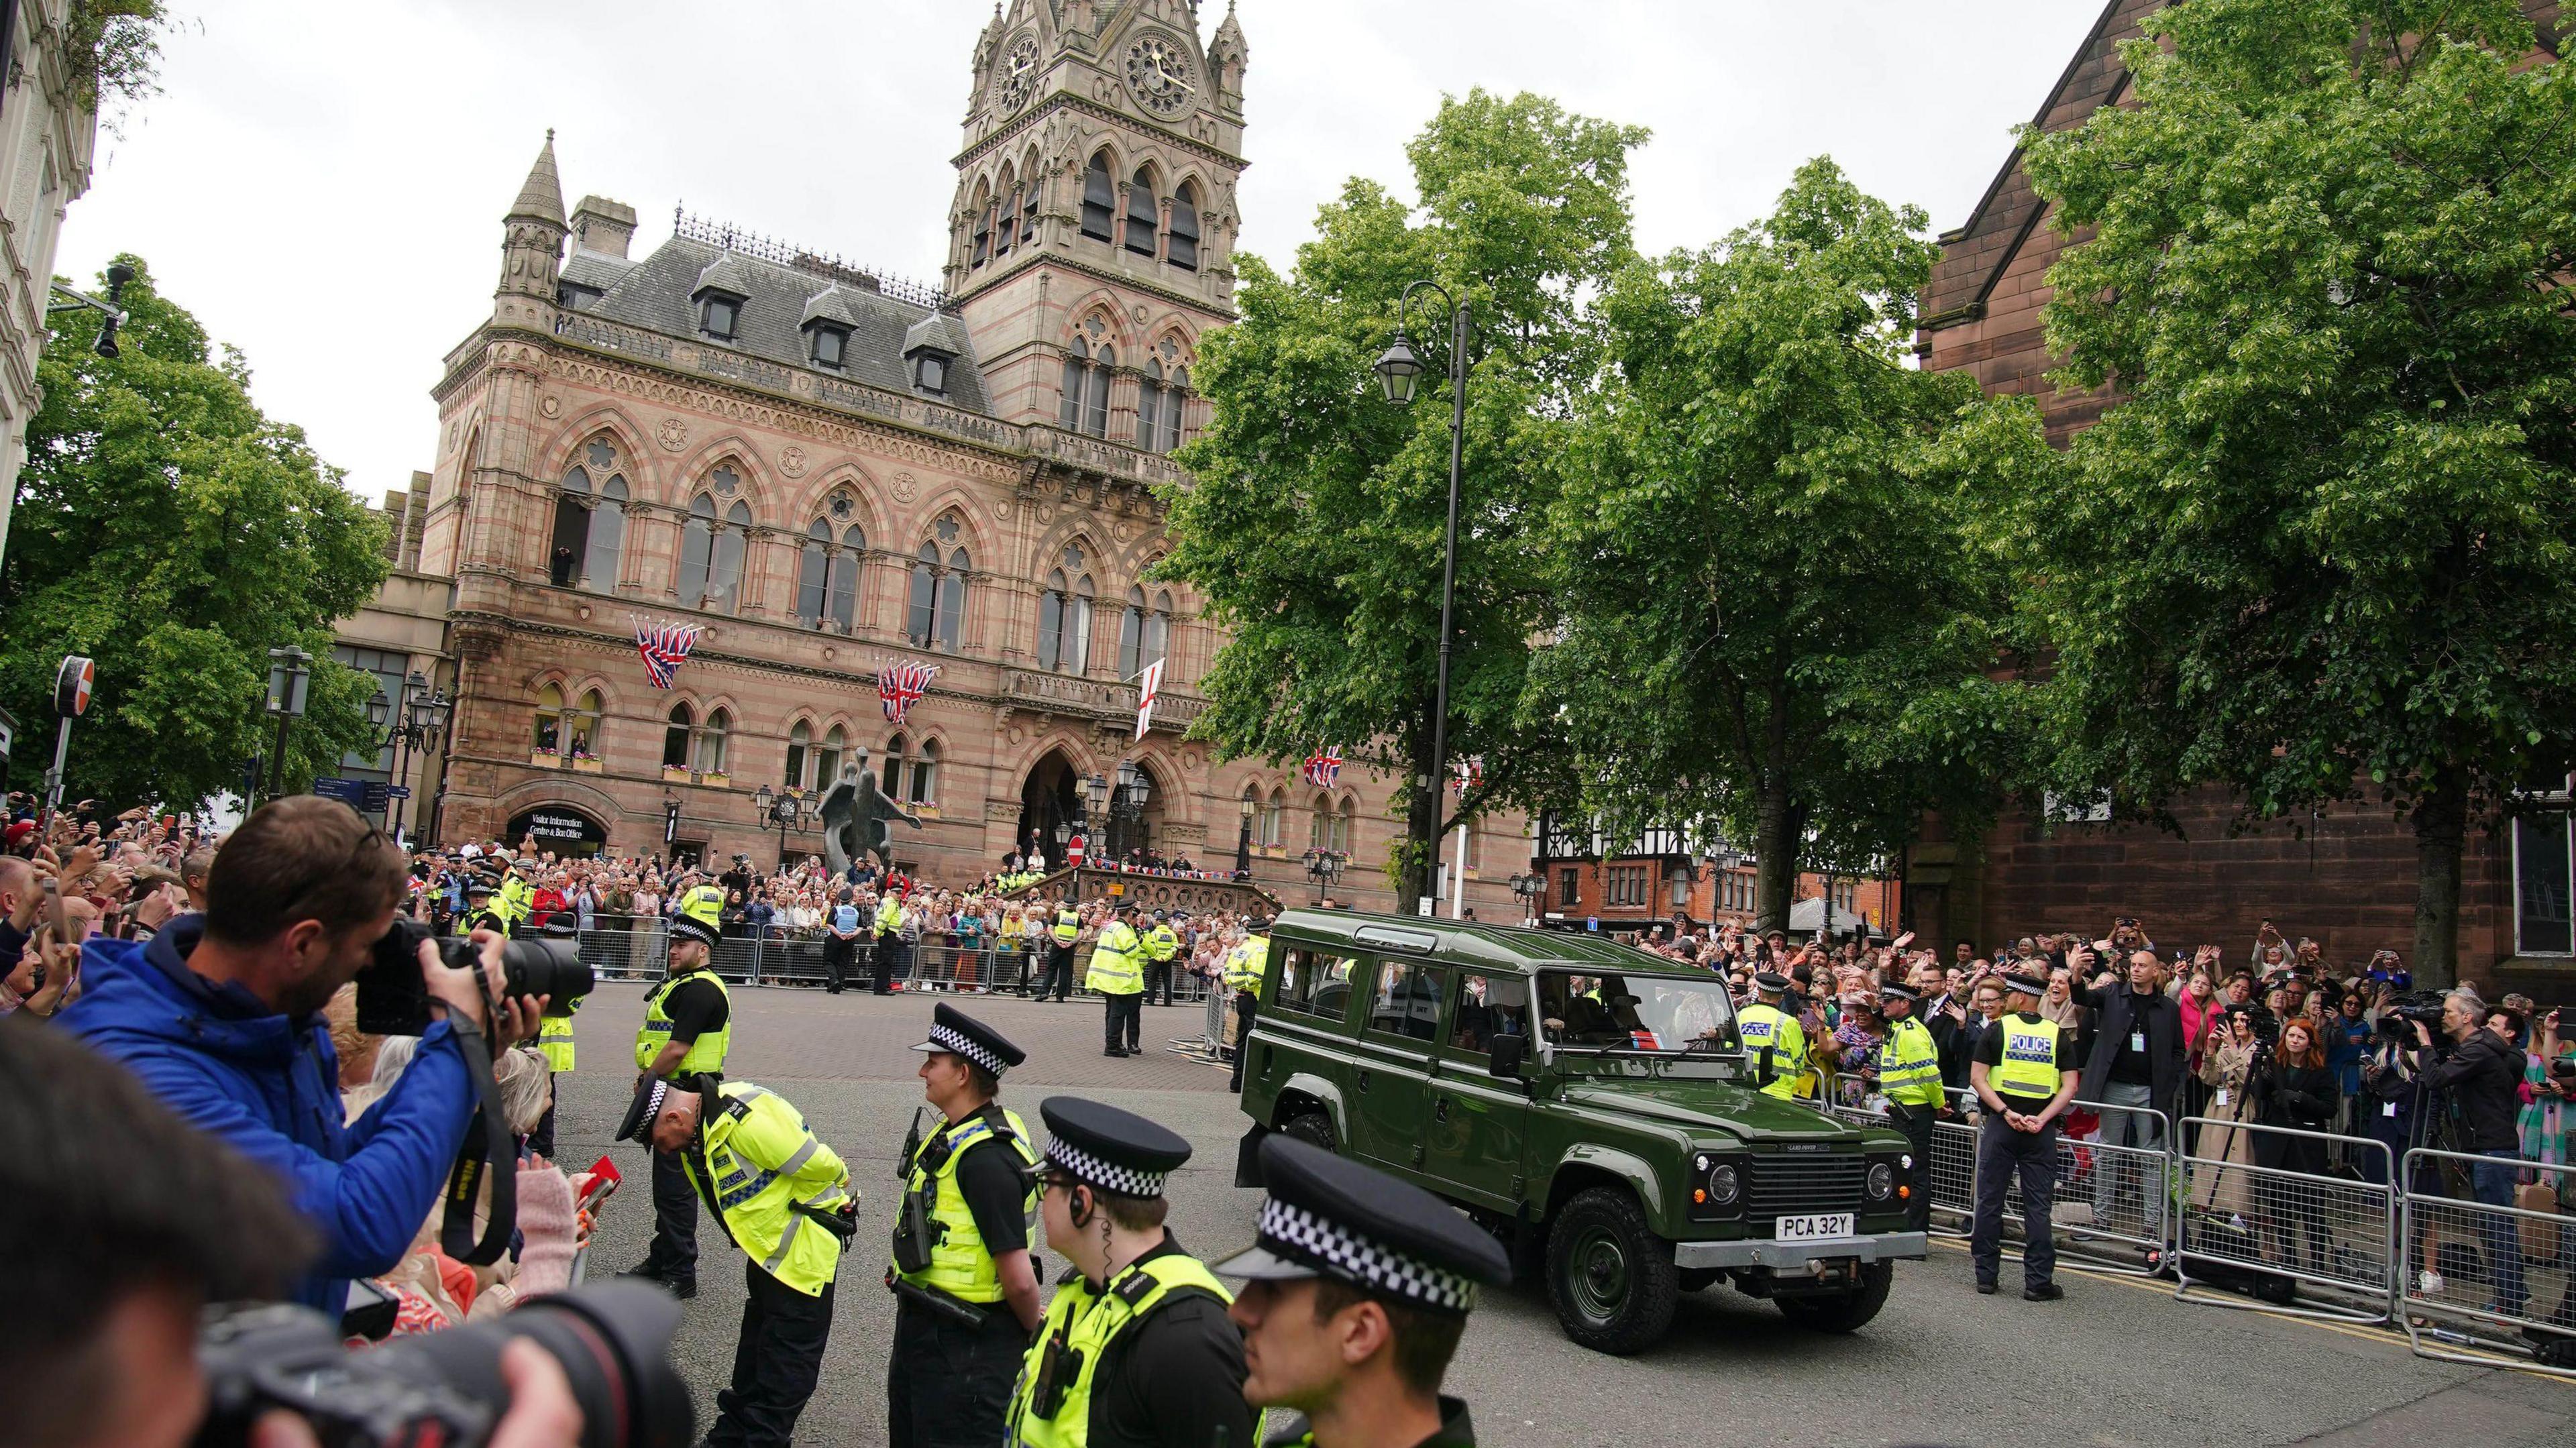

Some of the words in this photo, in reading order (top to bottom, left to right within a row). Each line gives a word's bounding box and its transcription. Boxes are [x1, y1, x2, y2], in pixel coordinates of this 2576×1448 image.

[532, 814, 548, 824] Visitor
[549, 816, 582, 828] Information
[529, 825, 549, 836] Centre
[549, 829, 555, 837] &
[555, 828, 566, 837] Box
[566, 829, 582, 839] Office
[2010, 1035, 2051, 1052] POLICE
[714, 1159, 729, 1168] OLICE
[456, 1159, 478, 1201] Nikon
[720, 1171, 746, 1189] POLICE
[1784, 1218, 1815, 1236] PCA
[1819, 1216, 1847, 1234] 32Y
